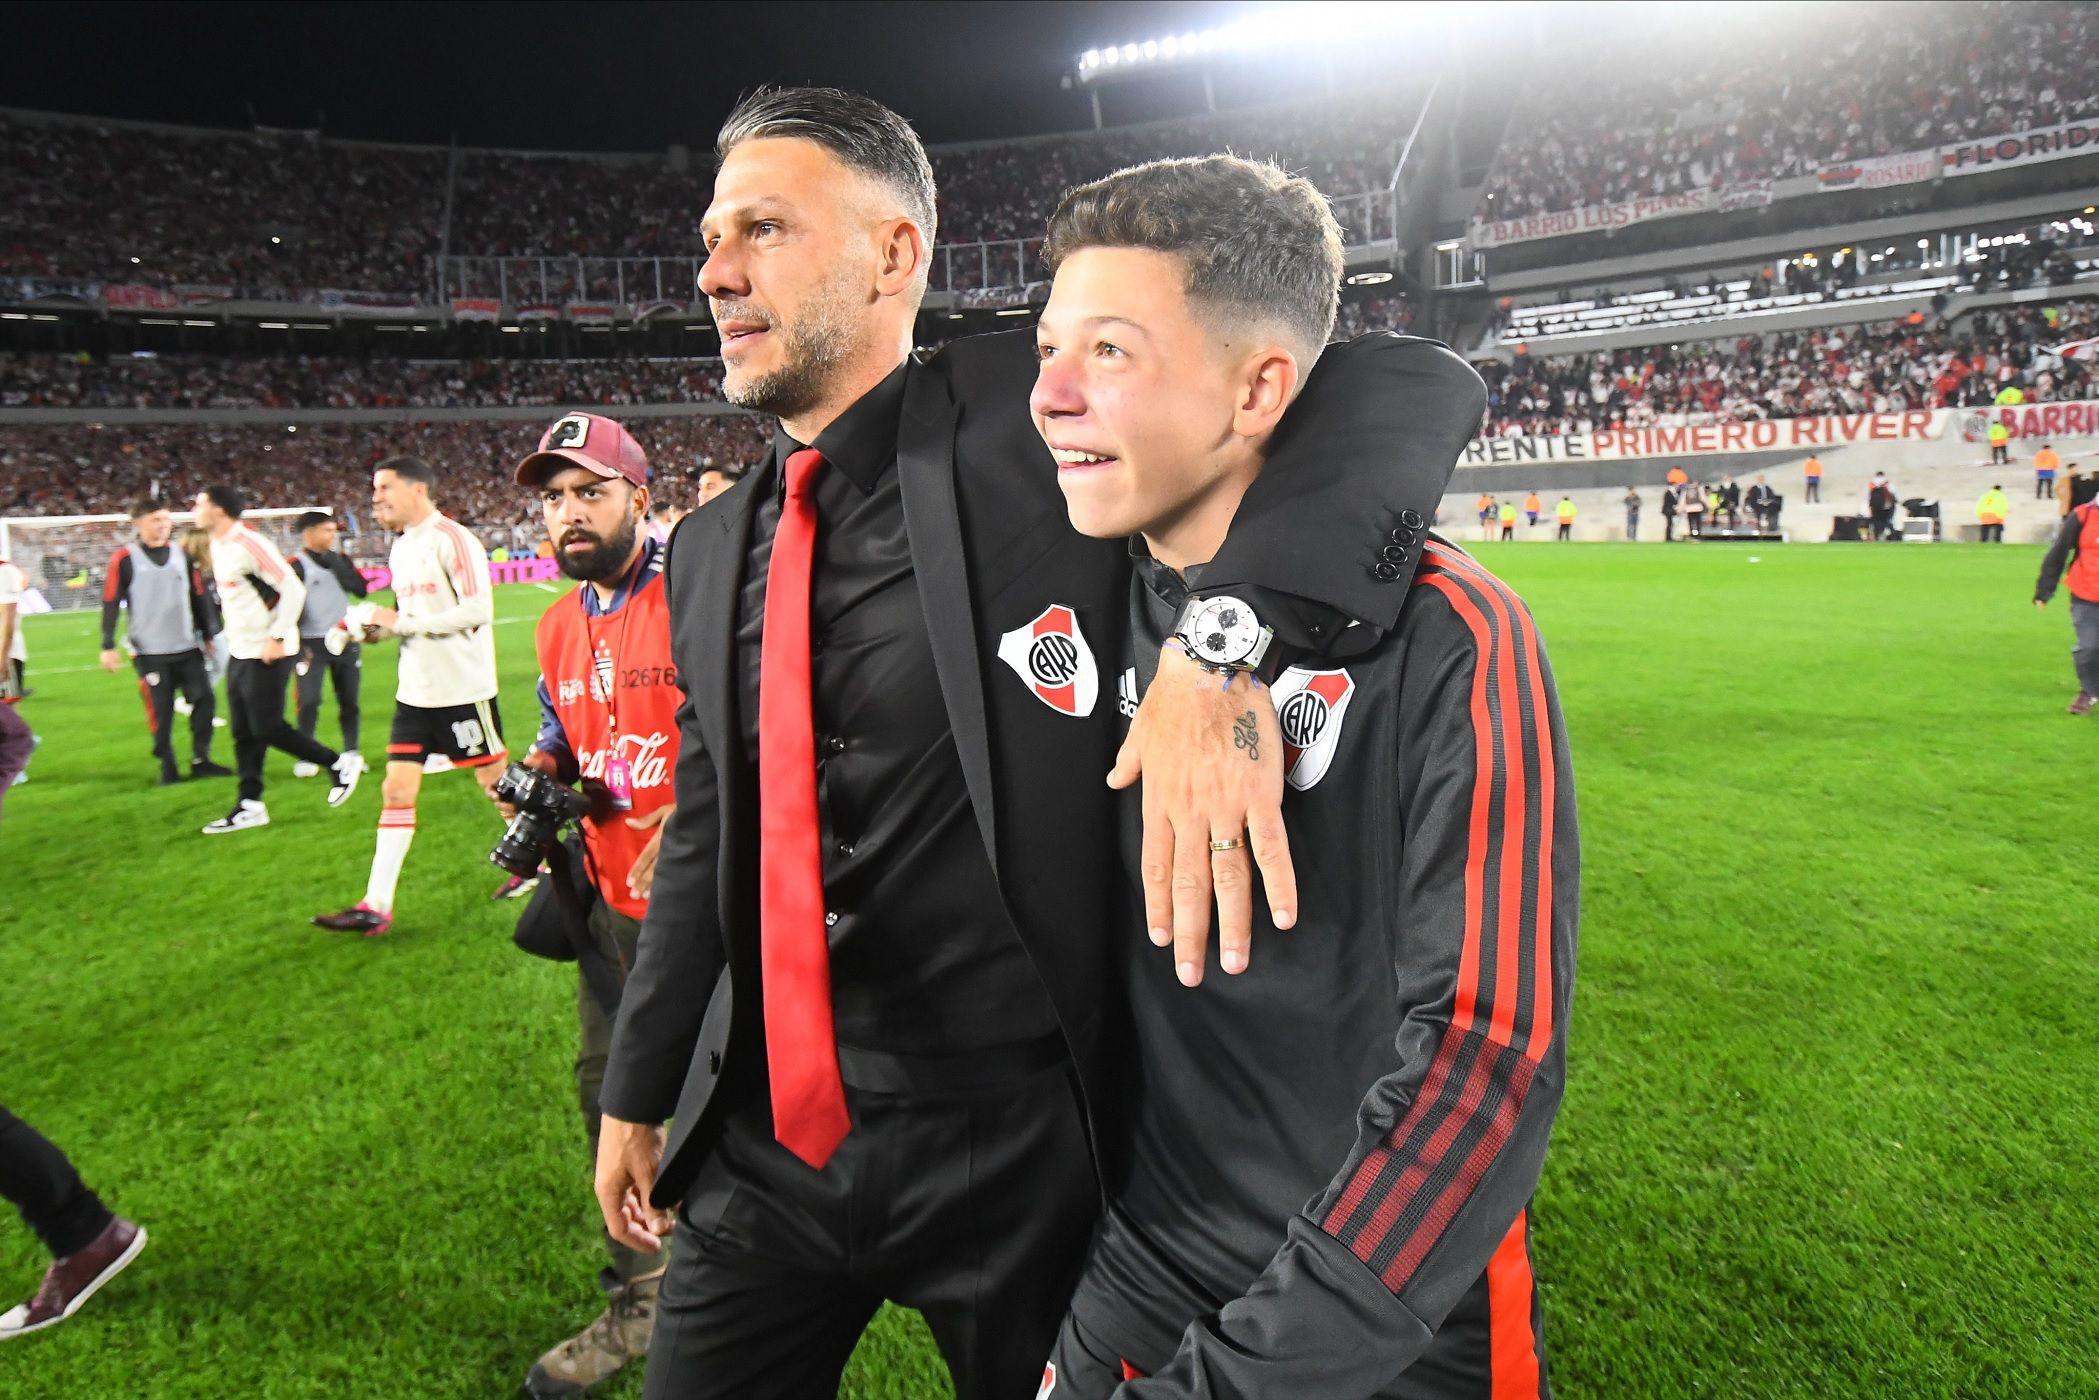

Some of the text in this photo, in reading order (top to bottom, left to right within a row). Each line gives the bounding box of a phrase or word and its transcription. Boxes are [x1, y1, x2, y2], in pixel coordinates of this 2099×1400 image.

[1954, 126, 2099, 168] FLORID
[1493, 209, 1578, 241] BARRIO
[1583, 204, 1628, 227] LOS
[1464, 432, 1585, 463] RENTE
[1592, 419, 1777, 457] PRIMERO
[1791, 409, 1934, 447] RIVER
[2001, 402, 2099, 438] BARRI
